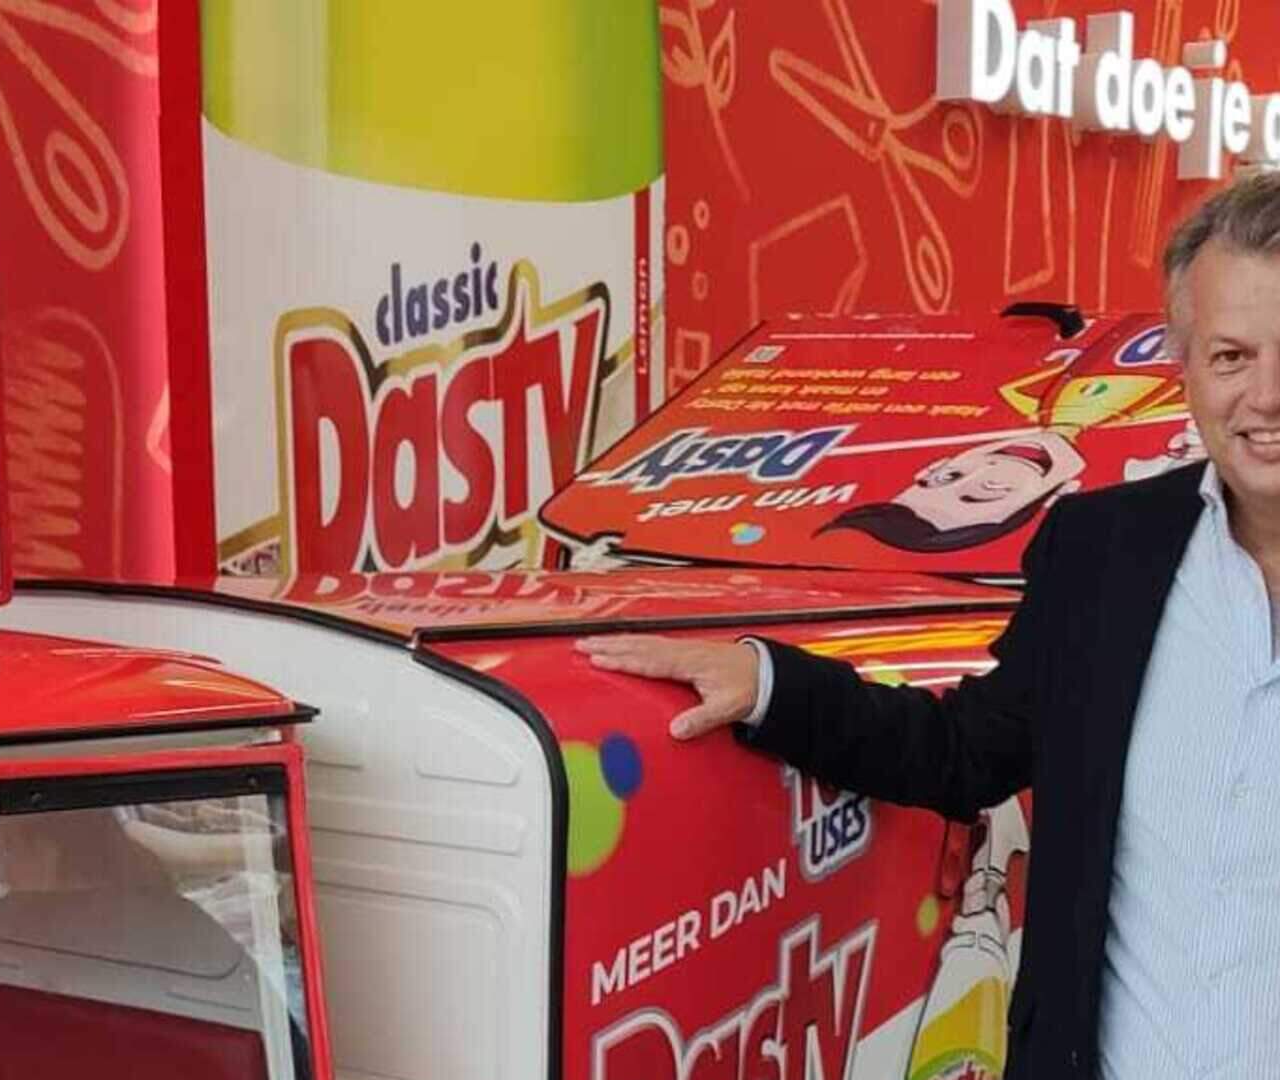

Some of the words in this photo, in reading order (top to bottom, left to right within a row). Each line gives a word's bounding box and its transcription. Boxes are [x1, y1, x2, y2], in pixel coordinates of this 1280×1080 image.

[970, 0, 1079, 119] Dat
[1095, 11, 1195, 143] doe
[1206, 40, 1251, 179] je
[375, 241, 500, 346] classic
[637, 257, 649, 375] Lemon
[288, 306, 603, 574] Dasty
[604, 426, 850, 491] Dasty
[635, 493, 750, 522] met
[751, 482, 860, 511] Win
[809, 799, 866, 866] USES
[591, 911, 701, 1006] MEER
[708, 859, 787, 939] DAN
